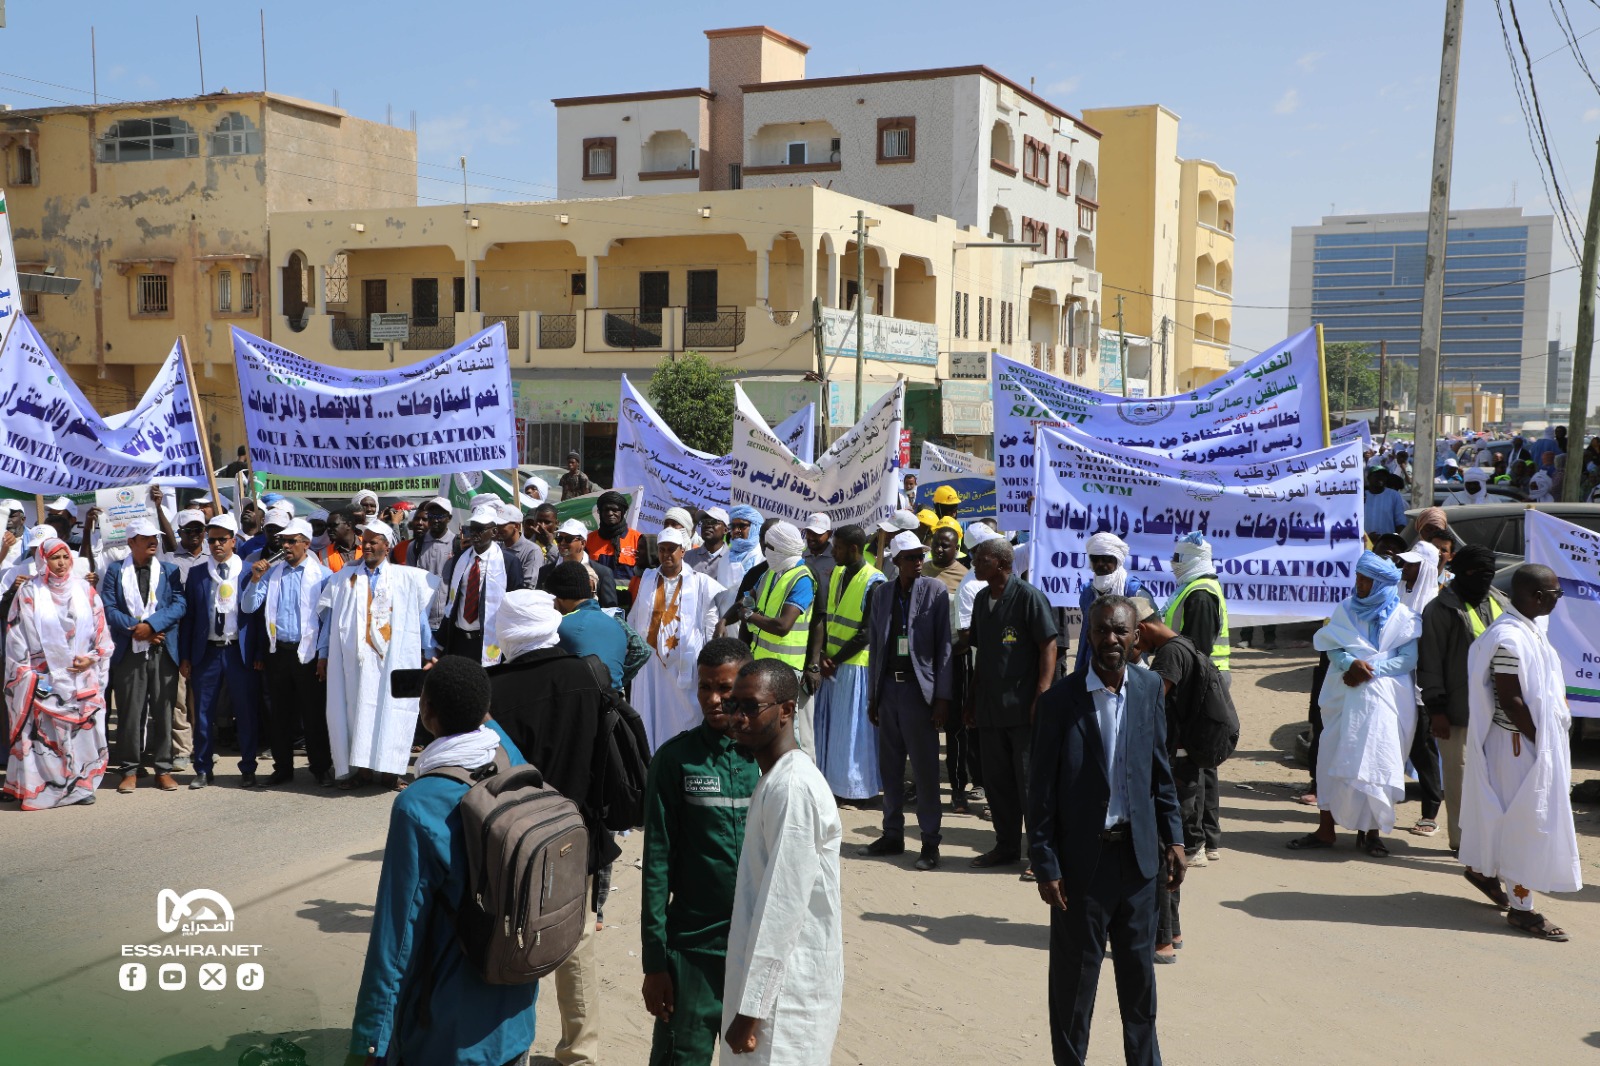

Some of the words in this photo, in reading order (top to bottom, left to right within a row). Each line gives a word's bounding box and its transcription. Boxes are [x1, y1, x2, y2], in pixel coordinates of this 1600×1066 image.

[1243, 351, 1292, 382] النقابة
[266, 374, 306, 386] CNTM
[998, 373, 1016, 382] DES
[1000, 383, 1022, 392] DES
[1061, 382, 1093, 396] LIBRE
[397, 386, 472, 420] للمفاوضات
[475, 384, 500, 418] نعم
[1190, 402, 1214, 418] النقل
[1030, 420, 1061, 428] SECTION
[1258, 410, 1300, 433] نطالب
[257, 428, 288, 446] OUI
[294, 430, 308, 448] À
[312, 435, 340, 450] LA
[345, 424, 496, 450] NÉGOCIATION
[1182, 421, 1254, 444] بالاستفادة
[1000, 434, 1018, 448] من
[1160, 436, 1178, 449] من
[1262, 434, 1302, 453] رئيس
[250, 447, 272, 464] NON
[274, 447, 280, 466] À
[283, 452, 361, 470] L'EXCLUSION
[364, 456, 380, 470] ET
[384, 454, 411, 470] AUX
[413, 443, 506, 468] SURENCHÈRES
[1182, 439, 1258, 464] الجمهورية
[998, 454, 1016, 468] 13
[1049, 460, 1072, 468] DES
[272, 480, 280, 490] LA
[282, 480, 338, 492] RECTIFICATION
[389, 480, 404, 490] DES
[406, 479, 420, 490] CAS
[422, 478, 431, 488] EN
[1002, 478, 1029, 487] NOUS
[1060, 470, 1076, 478] DE
[1080, 471, 1161, 487] MAURITANIE
[1006, 490, 1013, 500] 4
[1015, 490, 1033, 500] 500
[1082, 482, 1134, 497] CNTM
[1314, 479, 1358, 500] للشغيلة
[1235, 510, 1326, 546] للمفاوضات
[1330, 512, 1360, 550] نعم
[1560, 543, 1587, 554] DES
[1051, 552, 1086, 569] OU
[1130, 554, 1164, 572] LA
[1212, 558, 1352, 578] GOCIATION
[1572, 554, 1591, 563] DE
[1040, 576, 1071, 594] NON
[1074, 572, 1084, 594] À
[1223, 583, 1244, 600] UX
[1248, 580, 1351, 602] SURENCHÈRE
[1575, 668, 1593, 679] de
